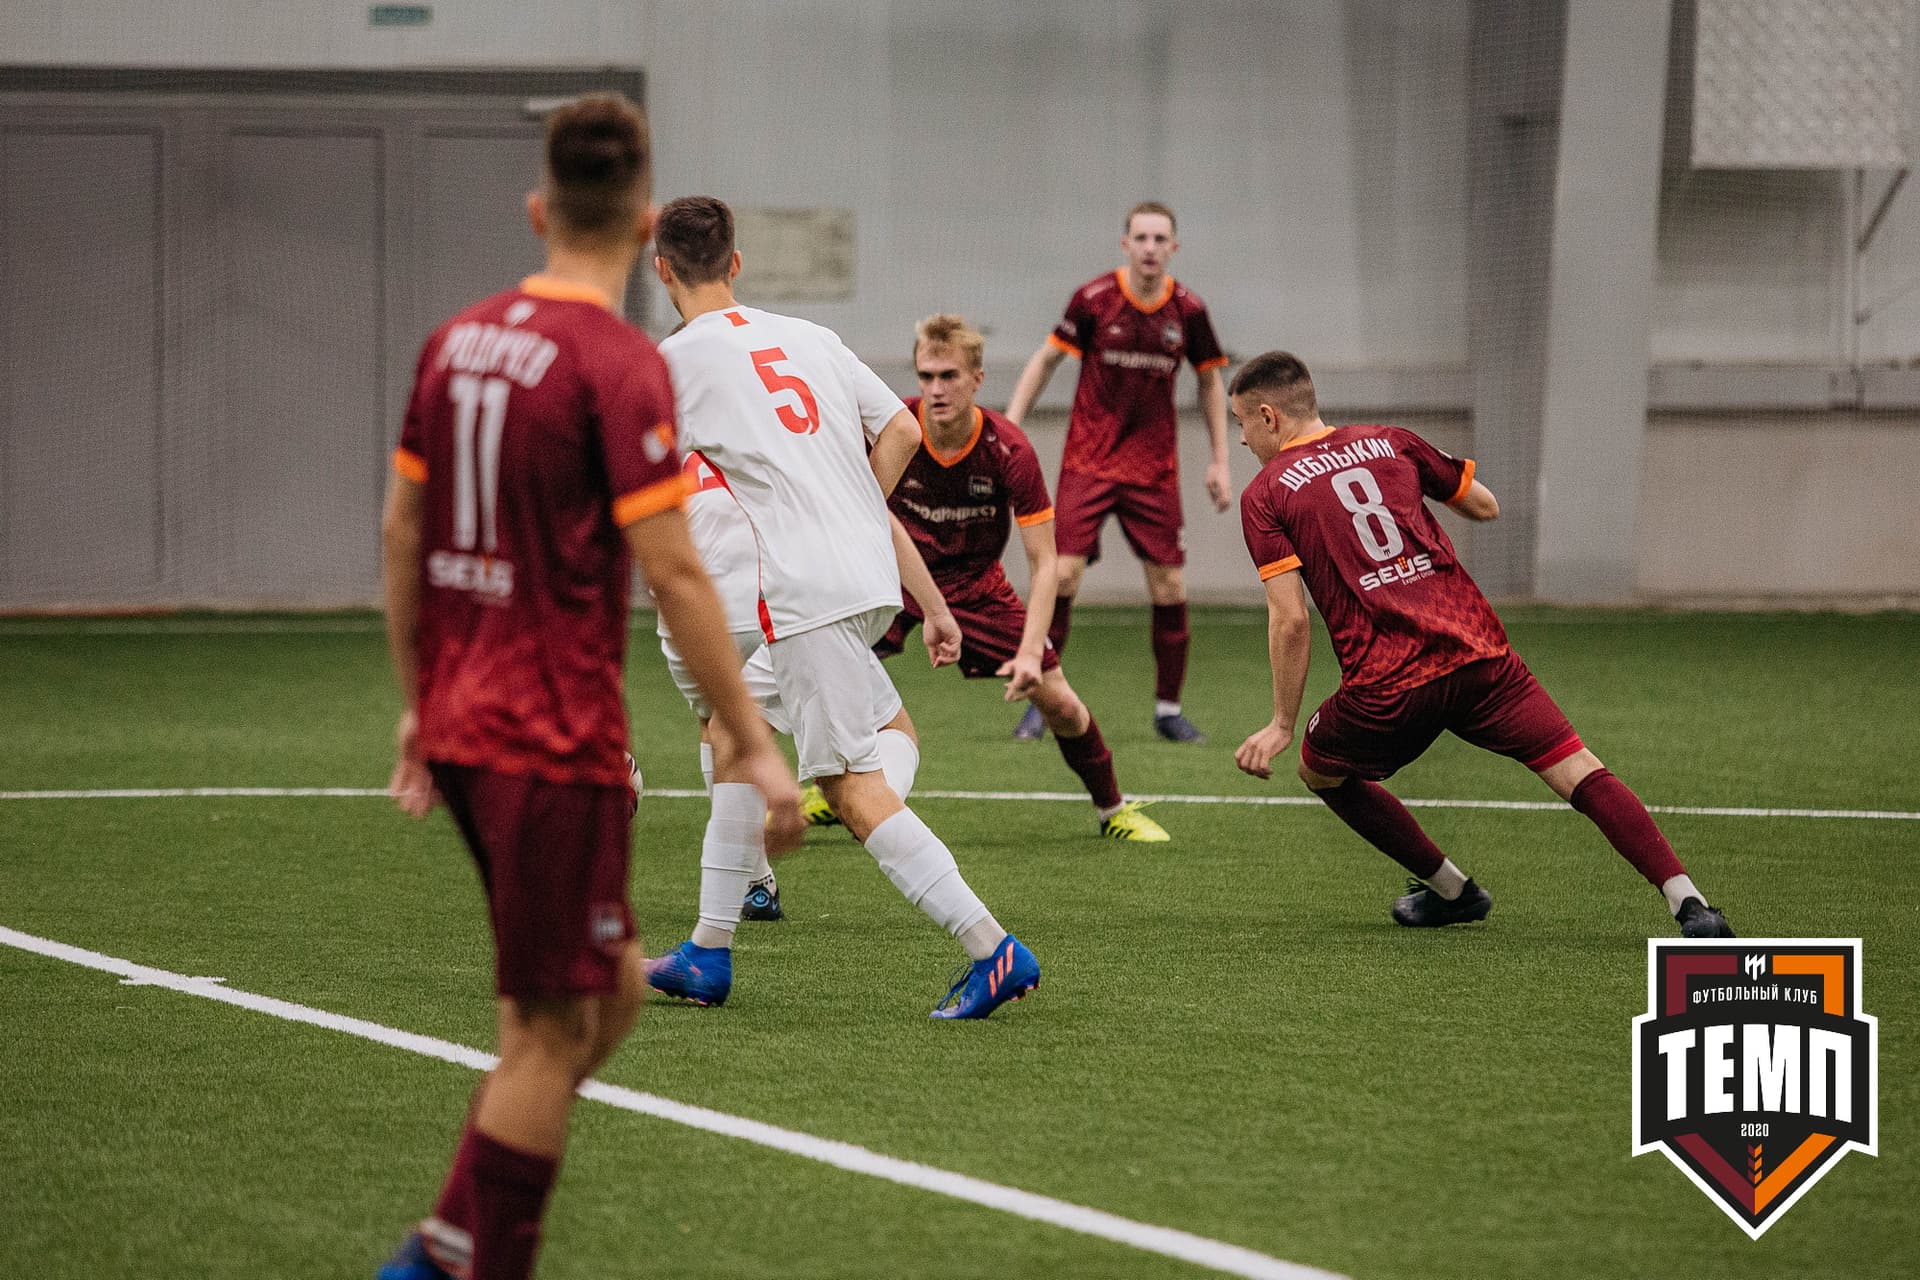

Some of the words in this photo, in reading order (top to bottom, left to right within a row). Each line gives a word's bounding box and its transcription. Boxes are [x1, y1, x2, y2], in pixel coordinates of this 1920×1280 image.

[749, 346, 820, 436] 5
[448, 372, 512, 552] 11
[1278, 438, 1396, 492] ЩЕБЛЫКИН
[1331, 467, 1404, 562] 8
